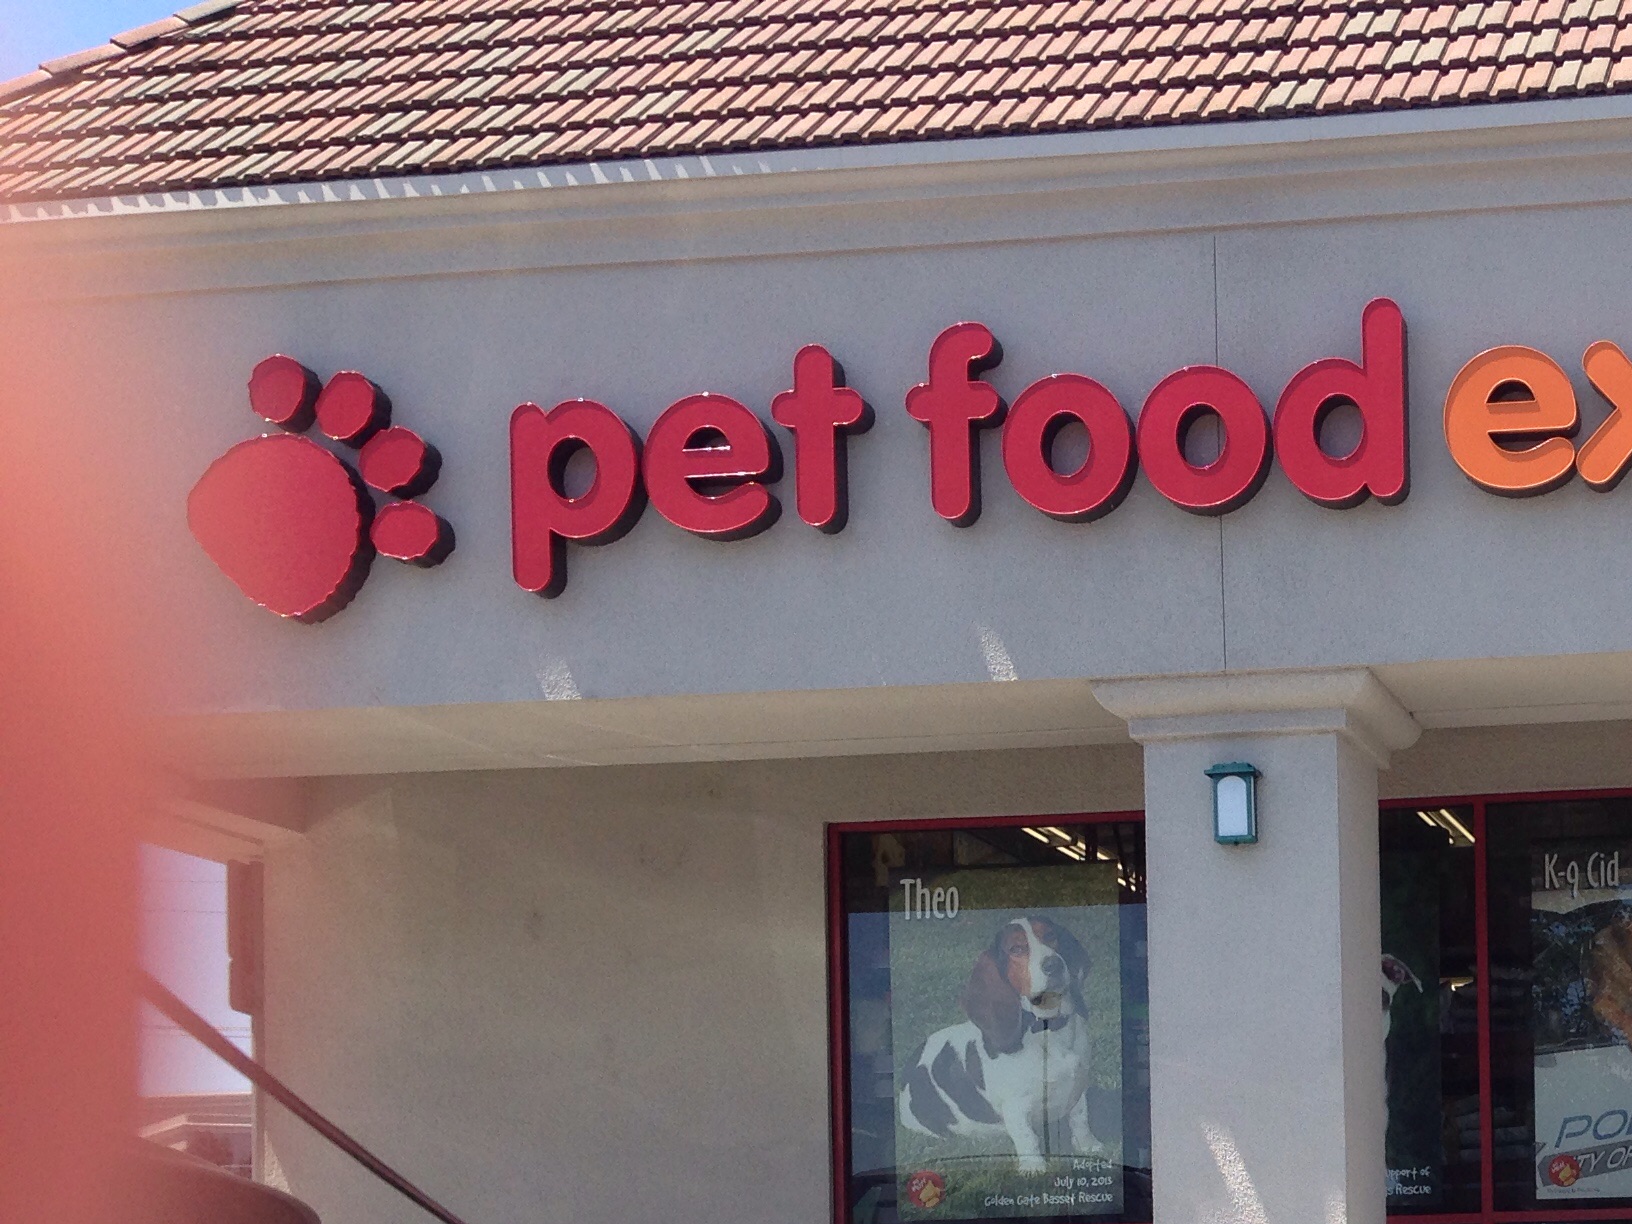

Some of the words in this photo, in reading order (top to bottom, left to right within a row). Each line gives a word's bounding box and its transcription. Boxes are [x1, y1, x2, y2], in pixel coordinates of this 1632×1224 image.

[510, 343, 870, 597] pet
[905, 297, 1410, 526] food
[1587, 851, 1619, 888] Cid
[899, 877, 960, 920] Theo
[1072, 1158, 1112, 1173] Adopted
[1574, 1150, 1606, 1173] TY
[1054, 1175, 1074, 1189] July
[1076, 1177, 1090, 1188] 10,
[1386, 1167, 1418, 1181] upport
[1395, 1183, 1432, 1195] Rescue
[984, 1194, 1015, 1207] Golden
[1016, 1194, 1041, 1208] Gate
[1043, 1192, 1076, 1206] Basset
[1078, 1191, 1114, 1203] Rescue
